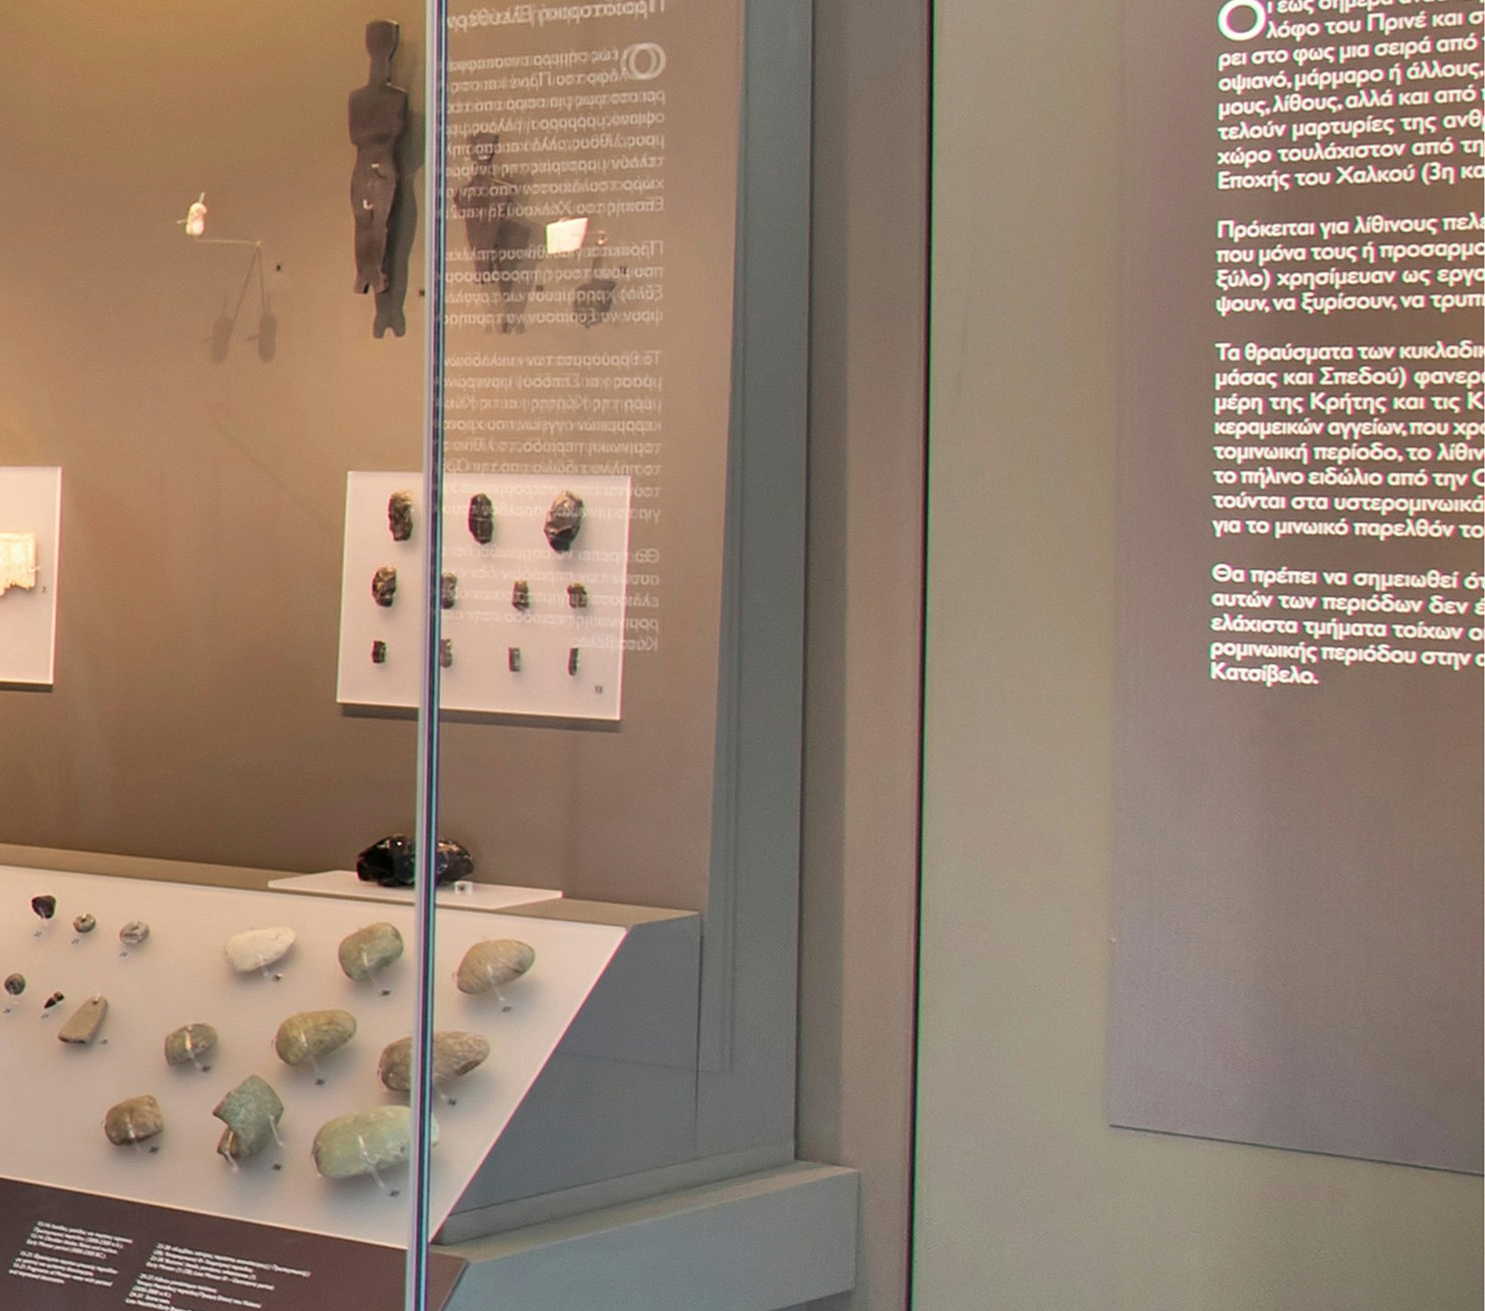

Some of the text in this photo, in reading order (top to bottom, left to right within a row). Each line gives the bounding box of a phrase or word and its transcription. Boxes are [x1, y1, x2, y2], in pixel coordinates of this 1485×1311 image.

[1265, 9, 1463, 40] λόφο του Πρινέ και
[1218, 32, 1478, 70] ρει στο φως μια σειρά από
[1294, 66, 1384, 91] μάρμαρο
[1388, 62, 1401, 85] ή
[1344, 86, 1393, 108] αλλά
[1398, 89, 1429, 105] και
[1433, 82, 1477, 103] από
[1216, 113, 1437, 140] τελούν μαρτυρίες της
[1216, 134, 1454, 169] χώρο τουλάχιστον από
[1217, 161, 1455, 192] Εποχής του Χαλκού (3η
[1217, 214, 1438, 242] Πρόκειται για λίθινους
[1215, 248, 1254, 263] που
[1258, 243, 1306, 266] μόνα
[1310, 246, 1358, 263] τους
[1361, 241, 1375, 264] ή
[1215, 265, 1431, 291] ξύλο) χρησίμευαν ως
[1271, 297, 1296, 311] να
[1399, 295, 1425, 309] να
[1215, 342, 1395, 365] Τα θραύσματα των
[1214, 366, 1407, 390] μάσας και Σπεδού)
[1214, 391, 1461, 414] μέρη της Κρήτης και τις
[1213, 415, 1324, 439] κεραμεικών
[1408, 420, 1449, 434] που
[1212, 441, 1308, 464] τομινωική
[1405, 446, 1432, 461] το
[1212, 466, 1468, 491] το πήλινο ειδώλιο από την
[1211, 490, 1286, 510] τούνται
[1290, 496, 1328, 510] στα
[1211, 516, 1455, 540] για το μινωικό παρελθόν
[1211, 564, 1458, 591] Θα πρέπει να σημειωθεί
[1210, 588, 1469, 615] αυτών των περιόδων δεν
[1210, 612, 1463, 644] ελάχιστα τμήματα τοίχων
[1209, 642, 1471, 670] ρομινωικής περιόδου στην
